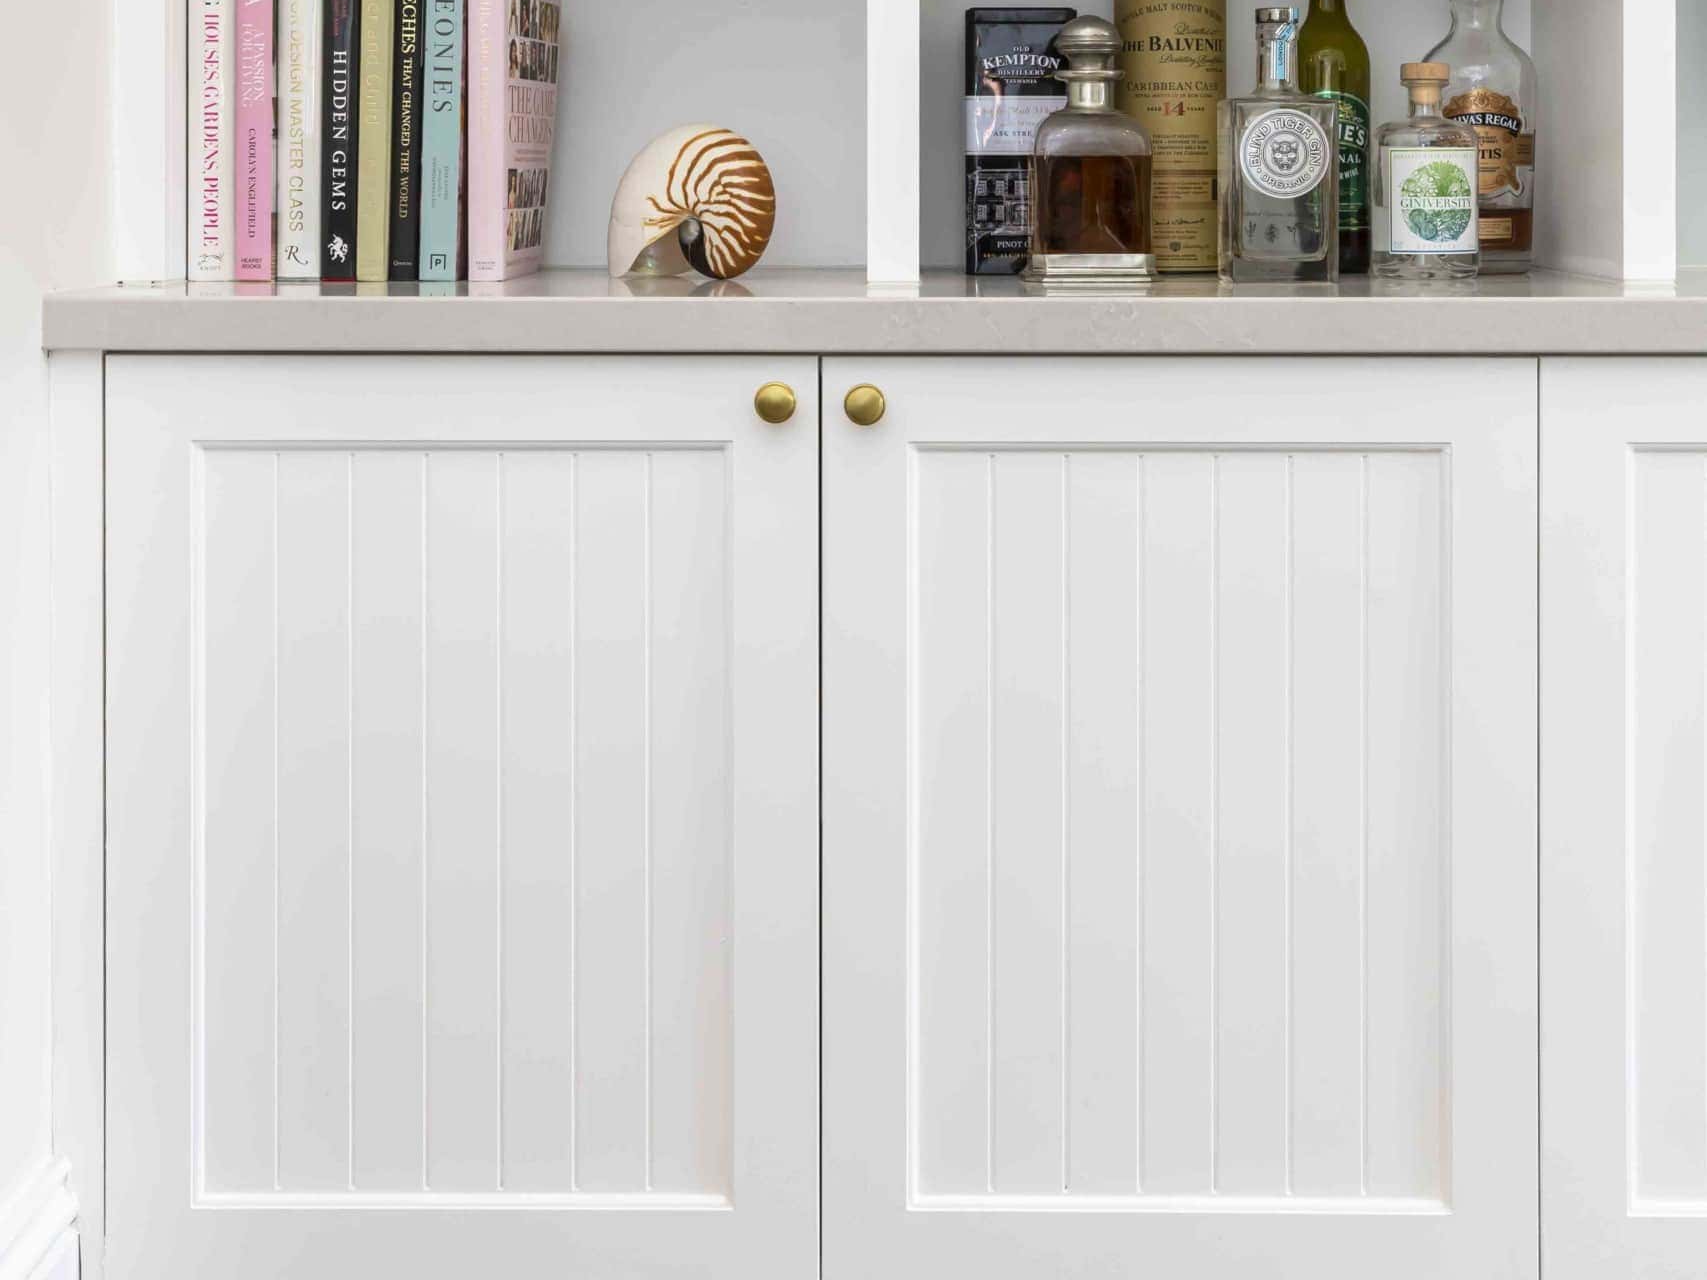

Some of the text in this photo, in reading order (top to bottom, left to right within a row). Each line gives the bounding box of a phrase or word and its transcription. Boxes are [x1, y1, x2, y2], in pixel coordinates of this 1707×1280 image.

[1146, 3, 1168, 14] MALT
[241, 23, 253, 107] FOR LIVING
[290, 30, 304, 92] DESIGN
[367, 30, 383, 65] and
[983, 53, 1061, 70] KEMPTON
[254, 43, 265, 103] PASSION
[332, 50, 348, 140] HIDDEN
[402, 57, 413, 89] THAT
[1128, 81, 1193, 91] CARIBBEAN
[365, 74, 383, 125] Child
[401, 91, 412, 146] CHANGED
[1162, 101, 1186, 116] 14
[1485, 114, 1518, 131] REGAL
[289, 99, 304, 169] MASTER
[1248, 124, 1271, 168] BLIND
[1270, 116, 1313, 139] TIGER
[1310, 138, 1322, 167] GIN
[248, 128, 257, 238] CAROLYN ENGLEFIELD
[331, 150, 347, 211] GEMS
[400, 150, 410, 173] THE
[1262, 171, 1311, 190] ORGANIC
[203, 177, 219, 247] PEOPLE
[289, 176, 304, 232] CLASS
[399, 176, 410, 219] WORLD
[1400, 198, 1472, 209] GINIVERSITY
[997, 240, 1022, 248] PINOT
